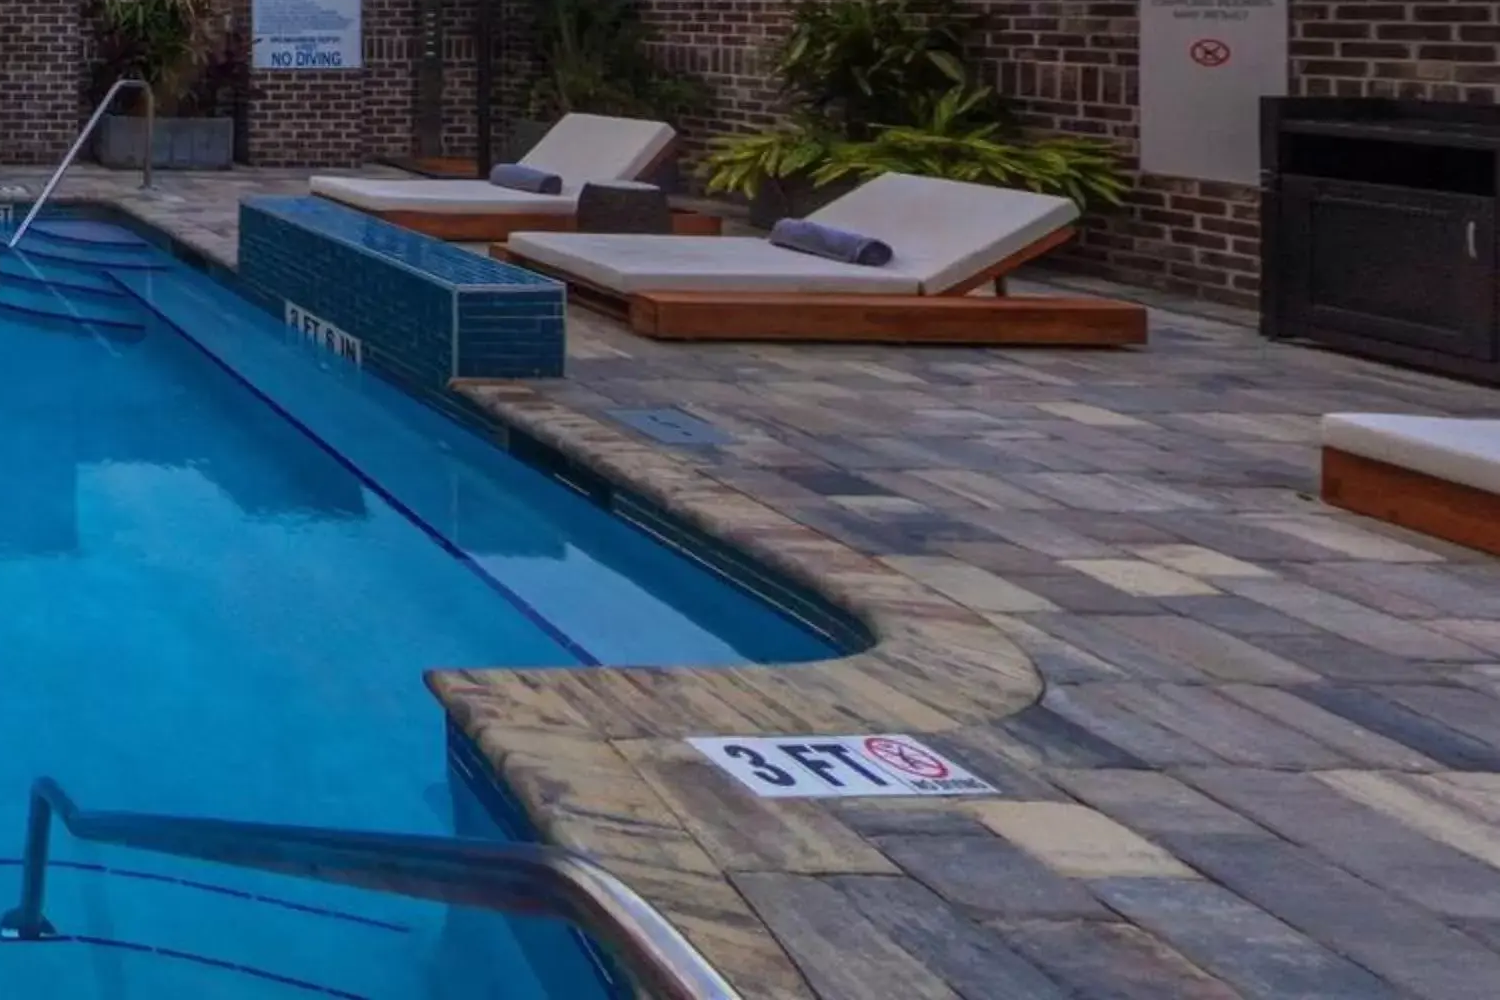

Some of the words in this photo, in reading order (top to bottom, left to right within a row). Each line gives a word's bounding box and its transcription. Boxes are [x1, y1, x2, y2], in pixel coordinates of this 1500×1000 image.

[271, 51, 292, 66] NO
[296, 51, 342, 66] DIVING
[723, 744, 796, 787] 3
[777, 743, 892, 787] FT
